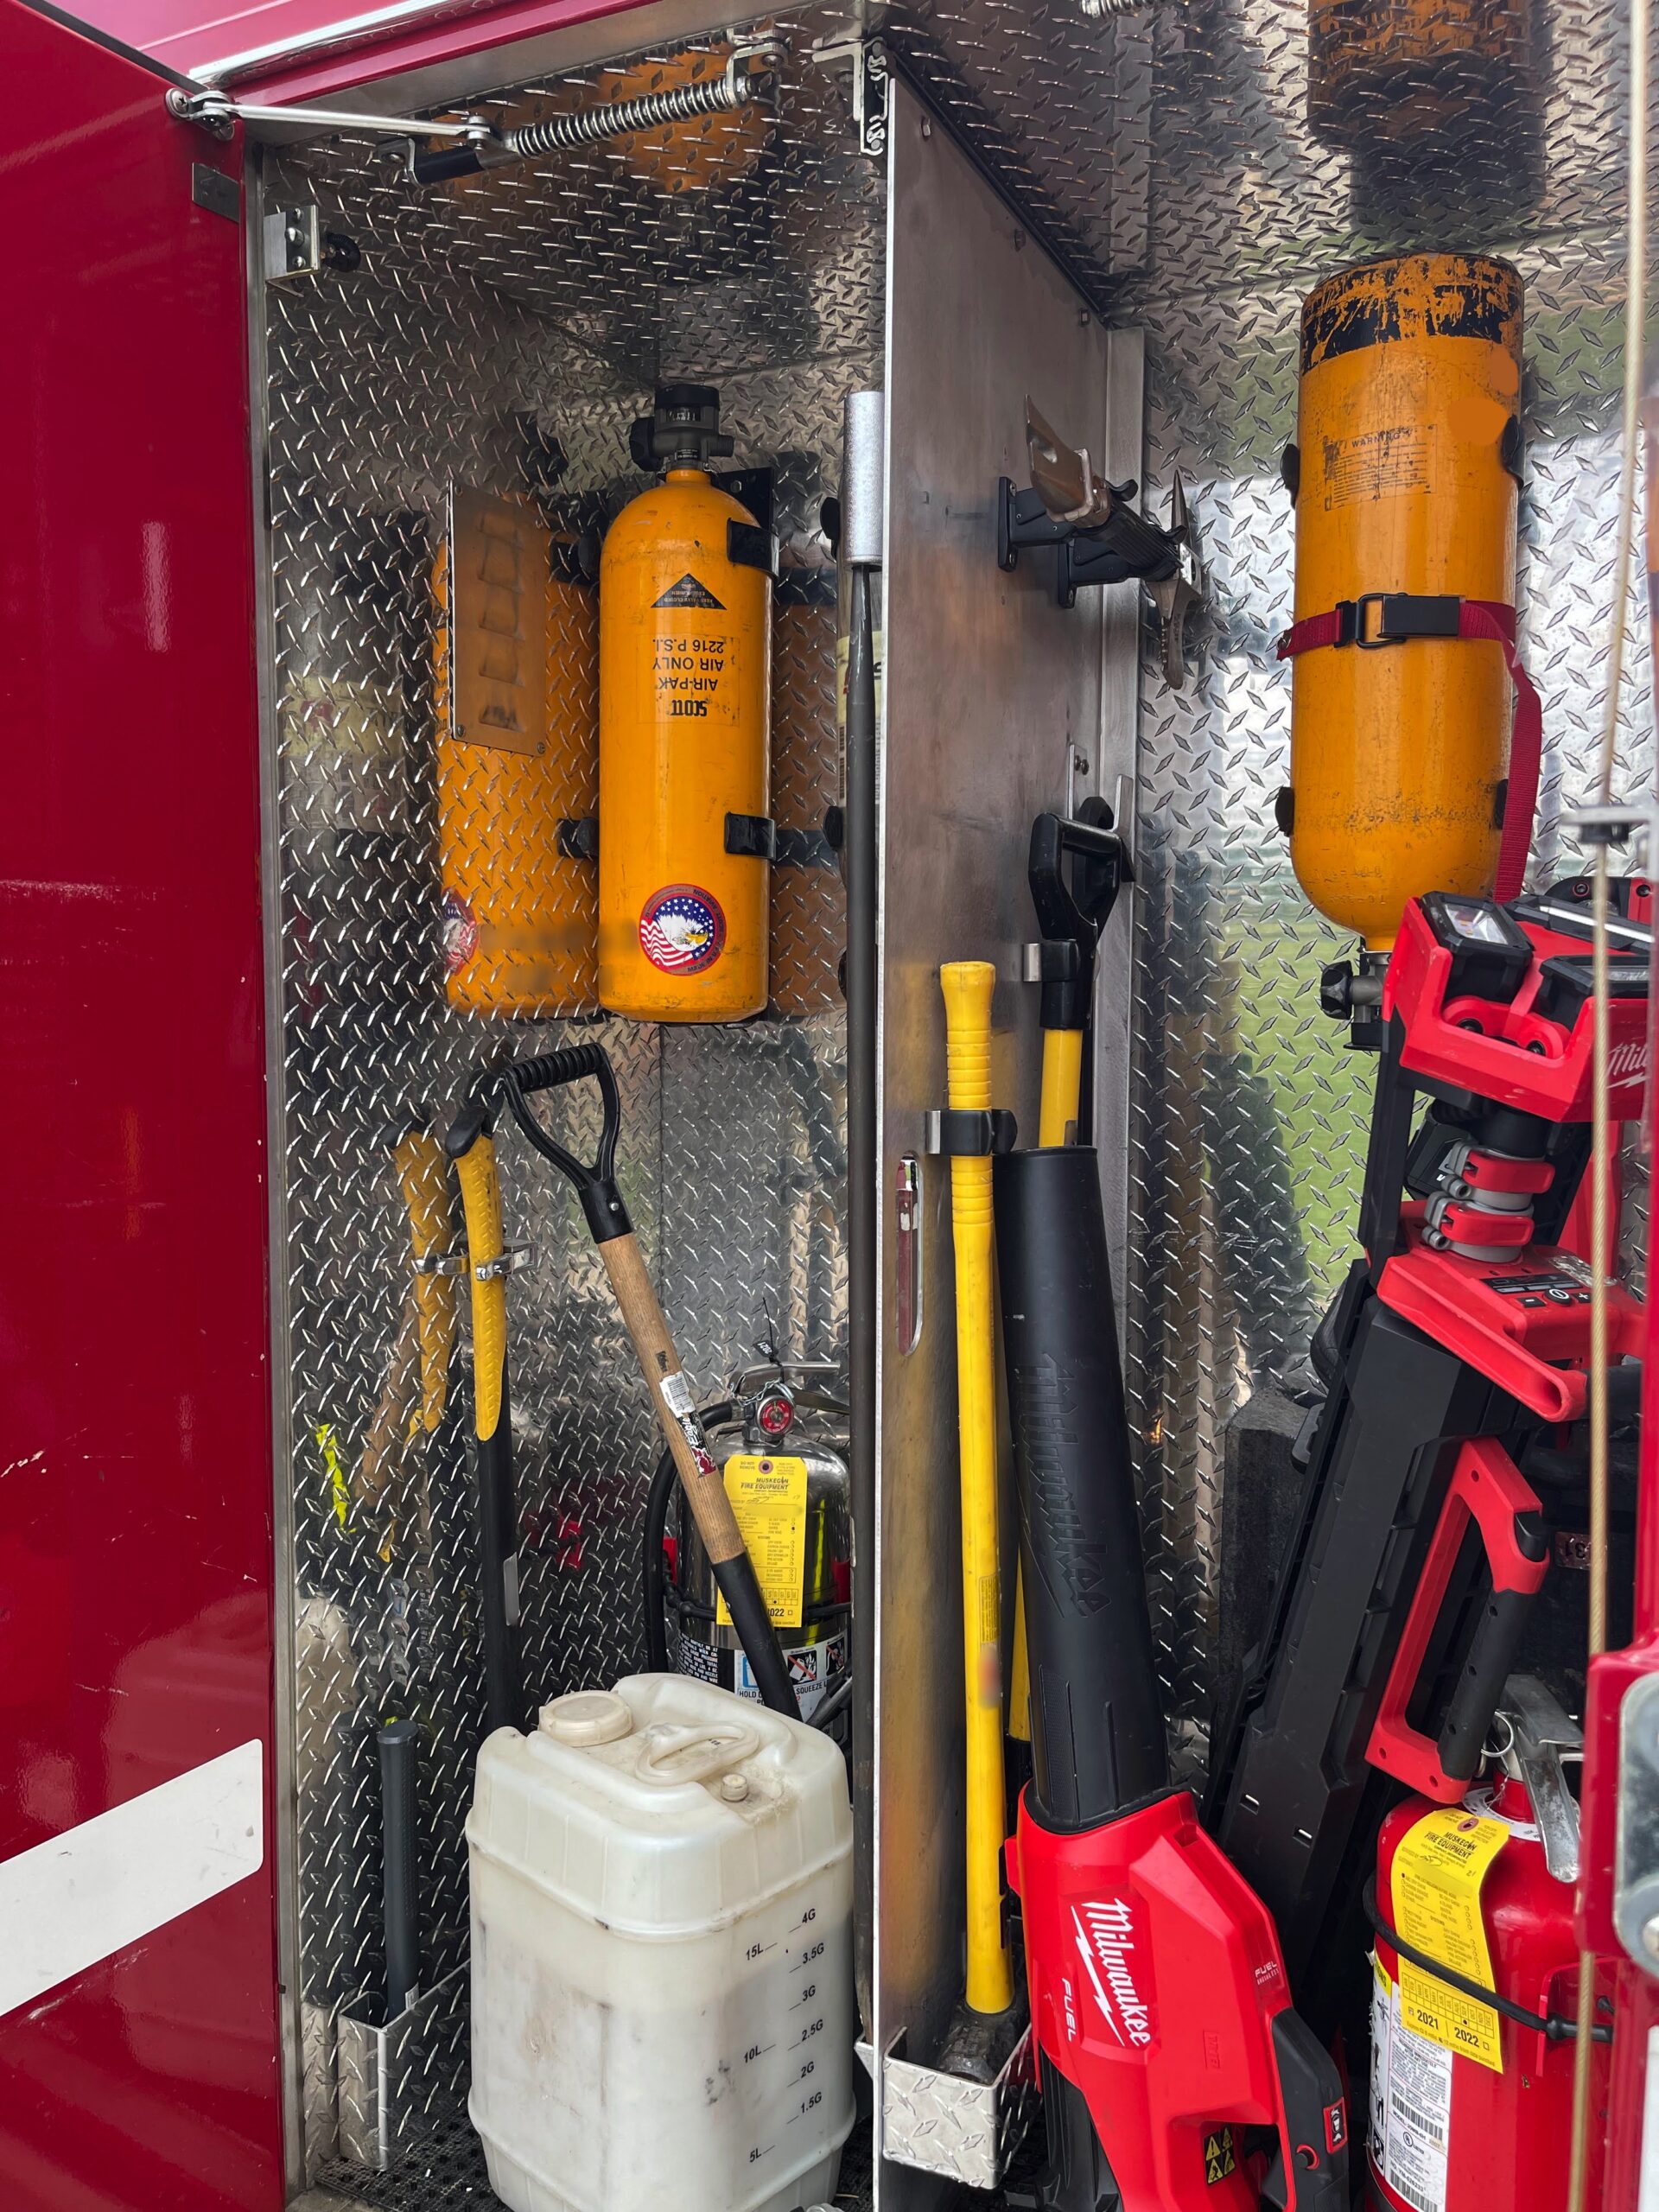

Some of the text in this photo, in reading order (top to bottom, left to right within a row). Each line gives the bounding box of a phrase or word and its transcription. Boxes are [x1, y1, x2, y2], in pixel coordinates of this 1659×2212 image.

[652, 639, 724, 653] 2216 P.S.I.
[652, 658, 724, 671] AIR ONLY
[658, 677, 718, 690] AIR-PAK
[671, 700, 708, 716] SCOTT
[797, 1682, 822, 1694] SQUEEZE
[1424, 1833, 1471, 1859] FIRE EQUIPMENT
[1443, 1832, 1477, 1851] MUSKEGON
[802, 1908, 816, 1924] 4G
[746, 1943, 764, 1961] 15L
[803, 1942, 824, 1964] 3.5G
[1082, 1897, 1151, 2047] Milwaukee
[1255, 1961, 1277, 1978] FUEL
[802, 1985, 816, 2002] 3G
[1061, 1977, 1075, 2042] FUEL
[802, 2019, 823, 2041] 2.5G
[1417, 2010, 1439, 2030] 2021
[1454, 2026, 1480, 2048] 2022
[744, 2045, 762, 2063] 10L
[801, 2061, 815, 2079] 2G
[801, 2091, 822, 2113] 1.5G
[749, 2147, 762, 2163] 5L
